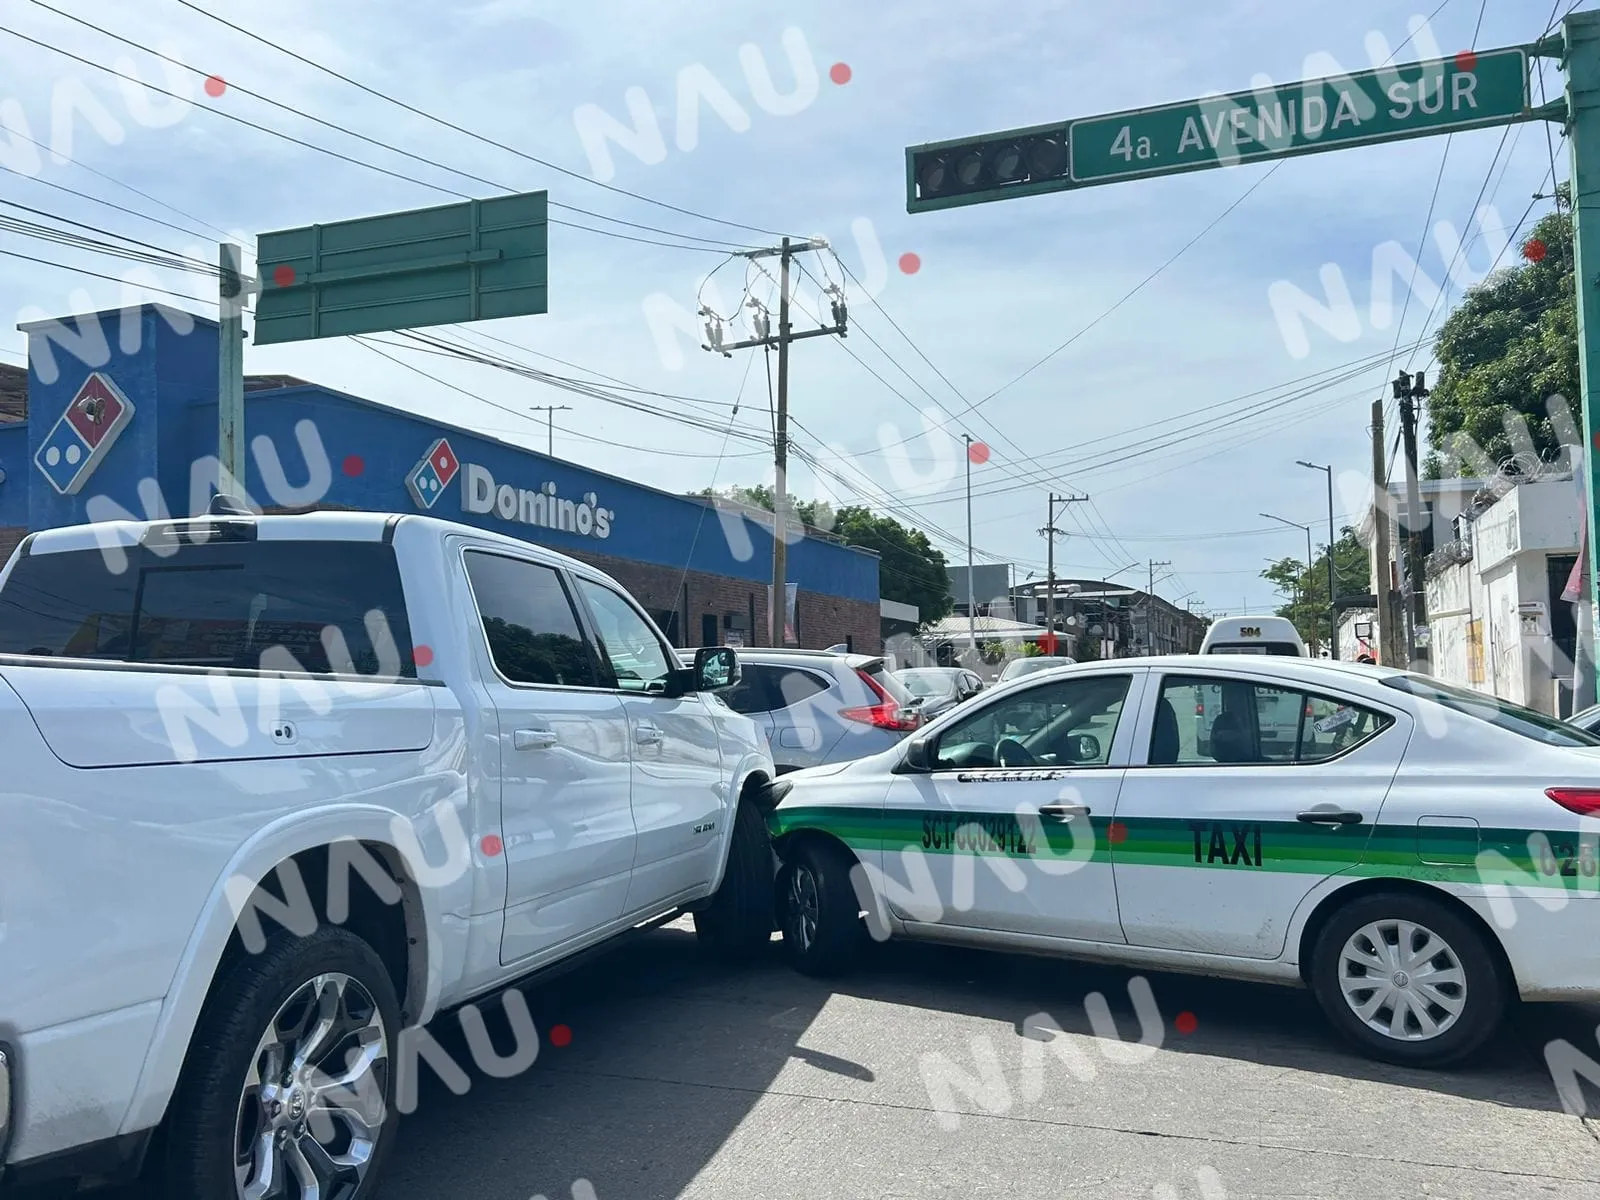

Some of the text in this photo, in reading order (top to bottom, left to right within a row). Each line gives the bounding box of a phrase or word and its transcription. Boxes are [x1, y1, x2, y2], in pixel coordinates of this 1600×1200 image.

[1110, 71, 1478, 161] 4a. AVENIDA SUR
[461, 463, 611, 539] Domino's
[1187, 821, 1262, 867] TAXI
